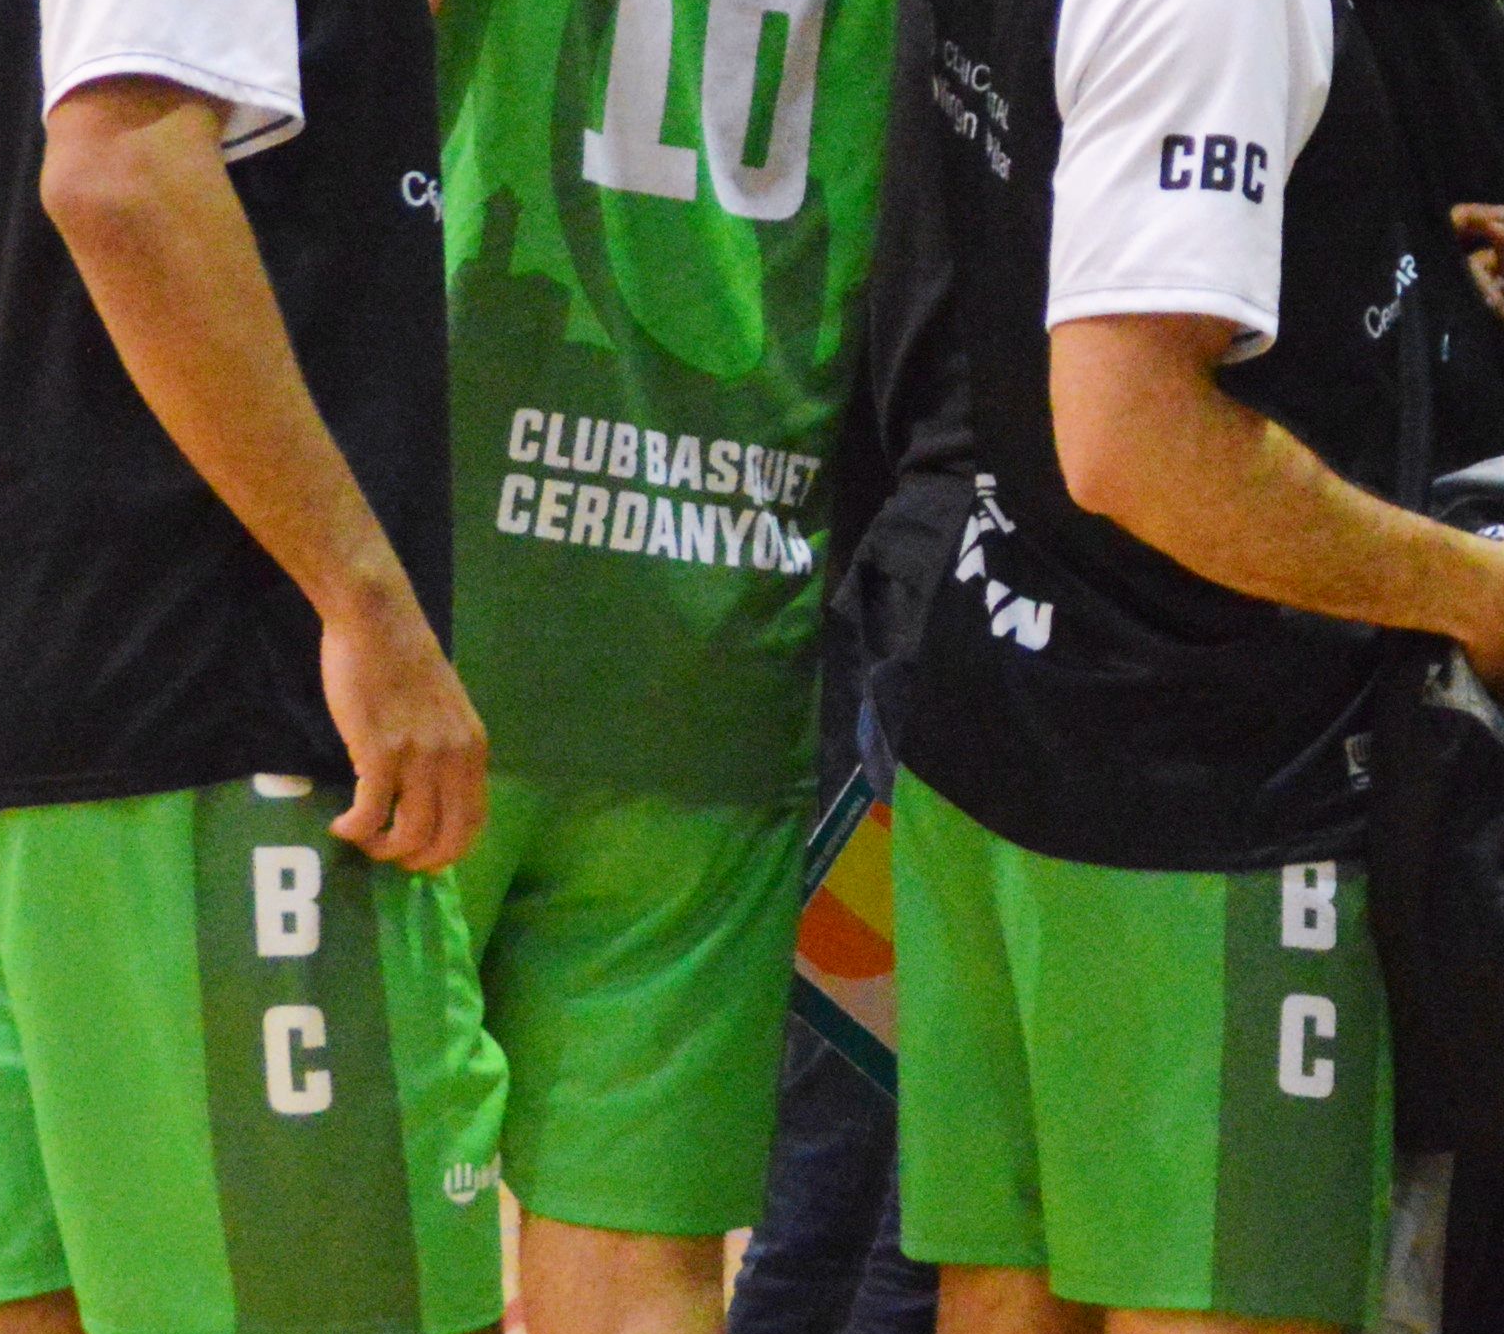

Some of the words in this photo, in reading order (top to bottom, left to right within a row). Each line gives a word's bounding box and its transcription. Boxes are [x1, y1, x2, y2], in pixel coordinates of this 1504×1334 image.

[1159, 132, 1269, 206] CBC
[508, 407, 639, 479] CLUB
[644, 428, 822, 507] BASQUET
